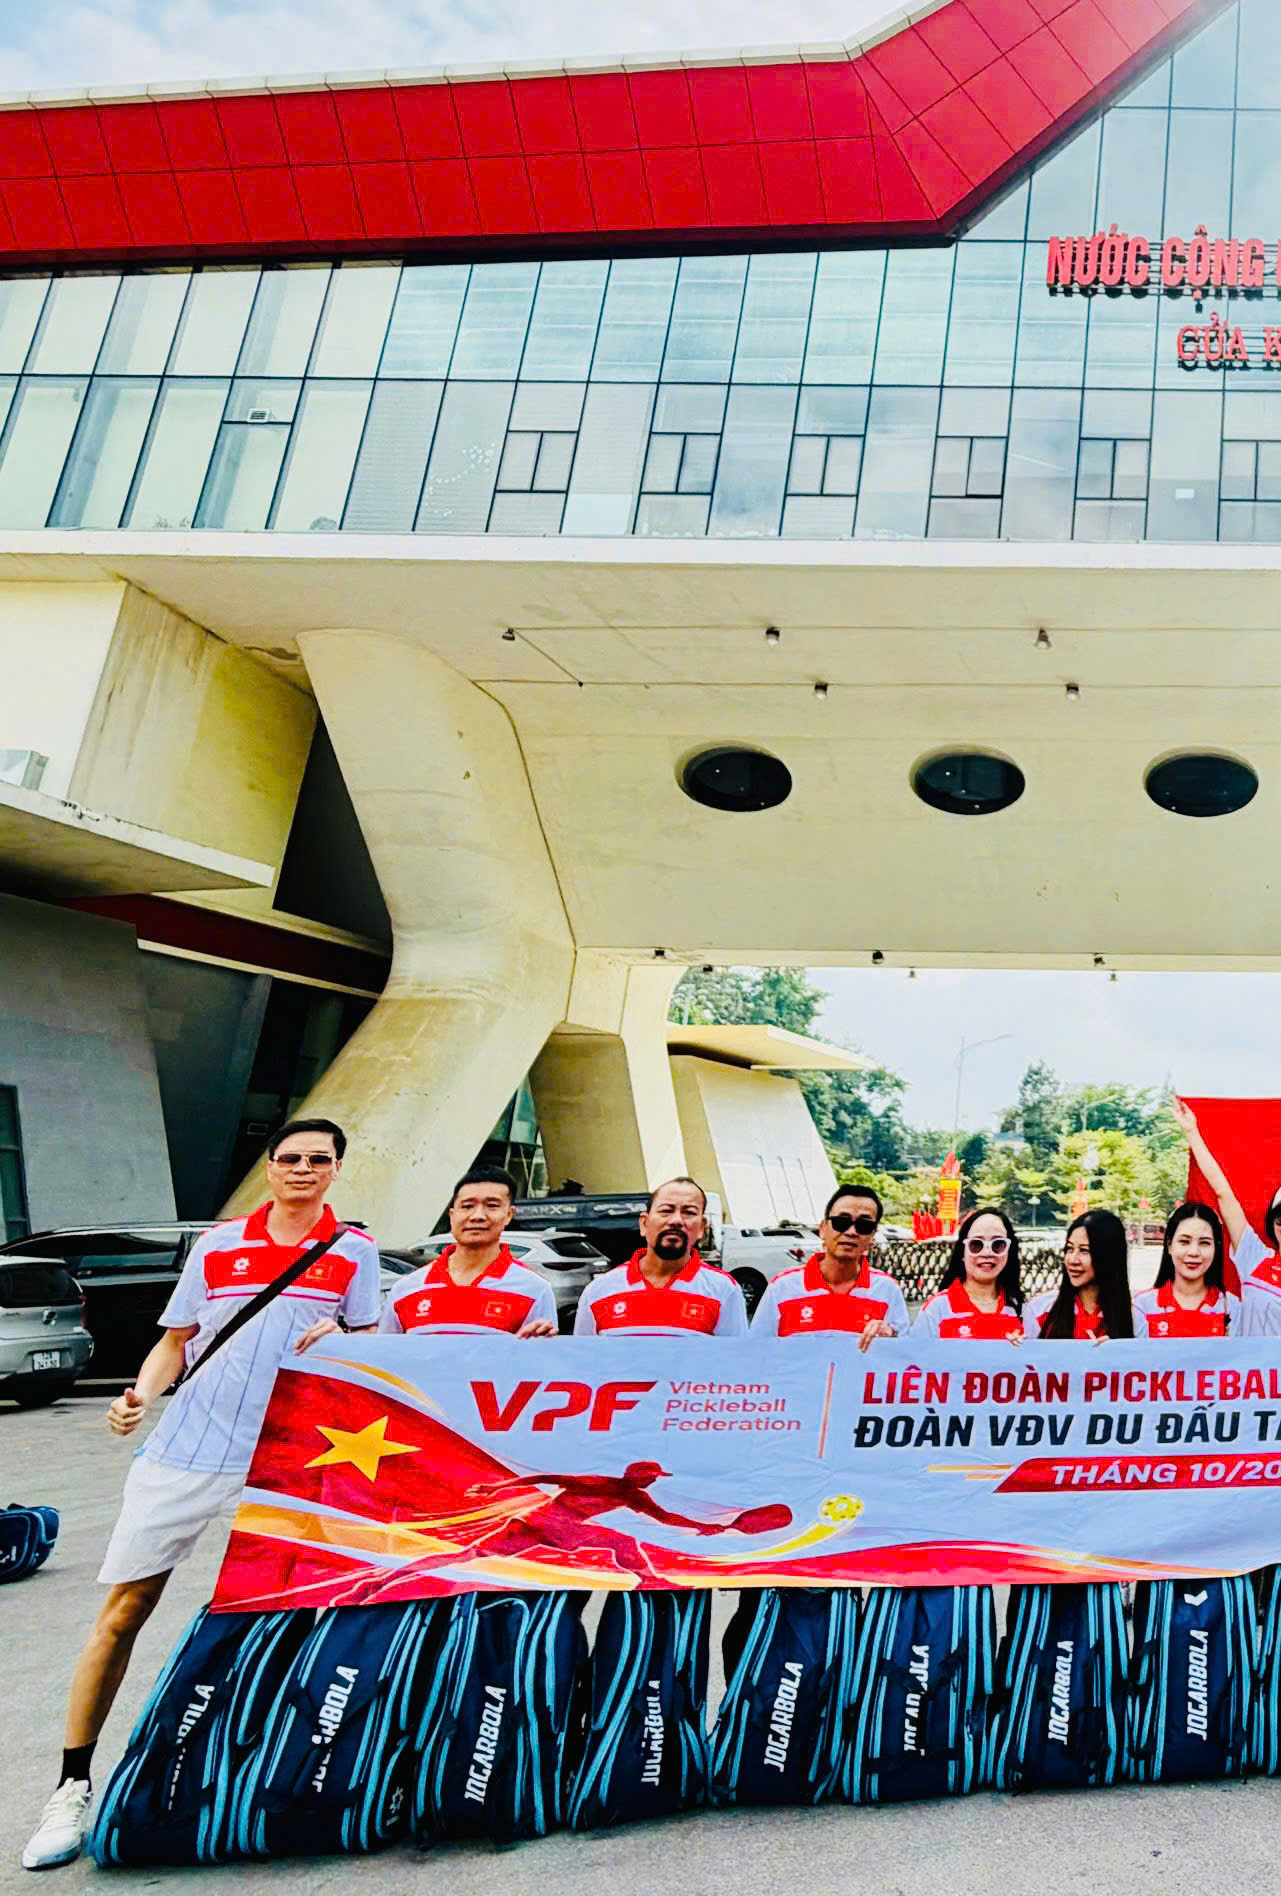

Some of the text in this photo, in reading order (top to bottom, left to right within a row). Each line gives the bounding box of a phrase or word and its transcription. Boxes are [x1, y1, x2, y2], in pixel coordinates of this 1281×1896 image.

[1047, 223, 1150, 287] NƯỚC
[1162, 224, 1265, 300] CỘNG
[1177, 311, 1249, 361] CỬA
[470, 1380, 658, 1432] VPF
[665, 1398, 786, 1413] Pickleball
[669, 1380, 770, 1395] Vietnam
[863, 1364, 950, 1405] LIÊN
[962, 1364, 1070, 1405] ĐOÀN
[662, 1417, 801, 1432] Federation
[853, 1407, 975, 1448] ĐOÀN
[988, 1414, 1074, 1447] VĐV
[1086, 1413, 1143, 1445] DU
[1156, 1403, 1240, 1443] ĐẤU
[1051, 1459, 1178, 1485] THÁNG
[1048, 1640, 1074, 1745] JOGARBOLA
[1186, 1629, 1209, 1741] JOGARBOLA
[763, 1661, 804, 1772] JOGARBOLA
[464, 1685, 507, 1805] JOGARBOLA
